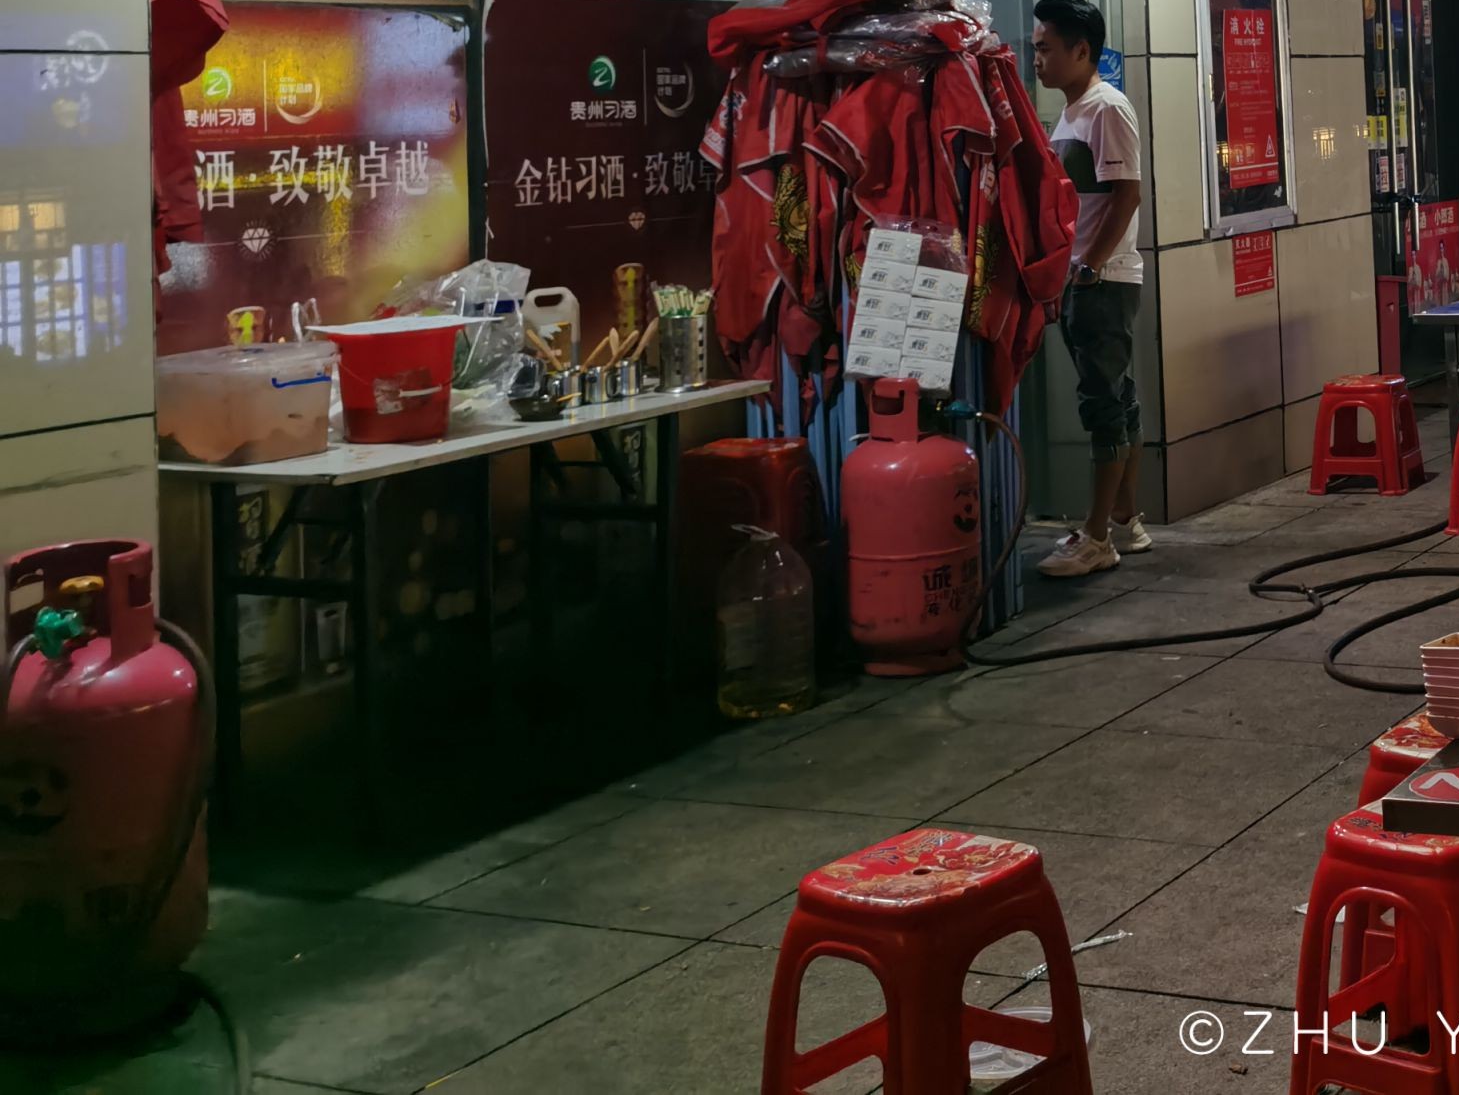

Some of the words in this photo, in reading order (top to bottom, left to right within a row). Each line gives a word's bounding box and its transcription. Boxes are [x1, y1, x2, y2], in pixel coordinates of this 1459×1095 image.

[1230, 17, 1265, 35] 消火栓
[184, 108, 256, 129] 贵州习酒
[570, 100, 637, 121] 贵州习酒
